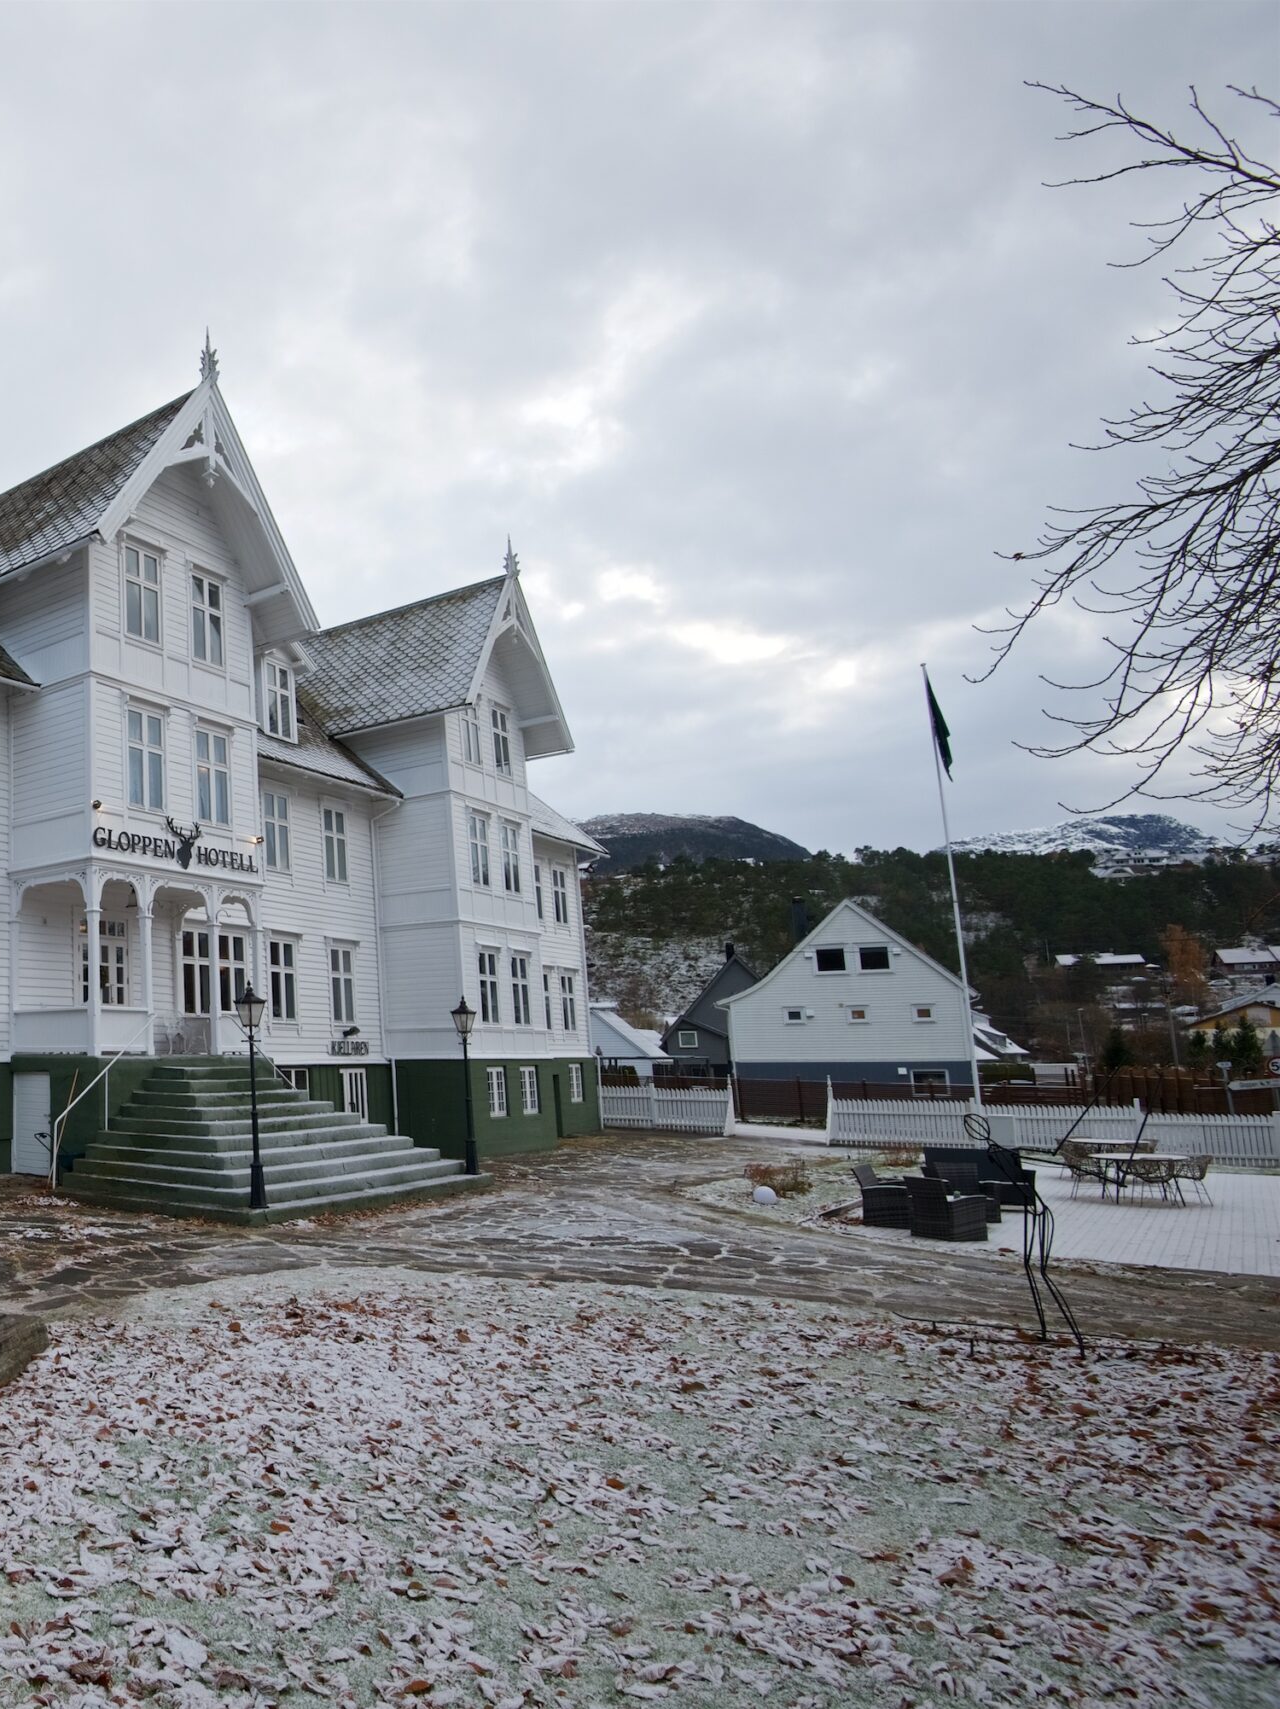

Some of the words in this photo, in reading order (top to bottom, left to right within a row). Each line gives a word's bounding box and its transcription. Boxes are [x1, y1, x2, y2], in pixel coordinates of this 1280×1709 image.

[93, 826, 176, 860] GLOPPEN
[197, 845, 259, 874] HOTELL
[331, 1040, 369, 1056] KJELLAREN
[1271, 1061, 1280, 1072] 5
